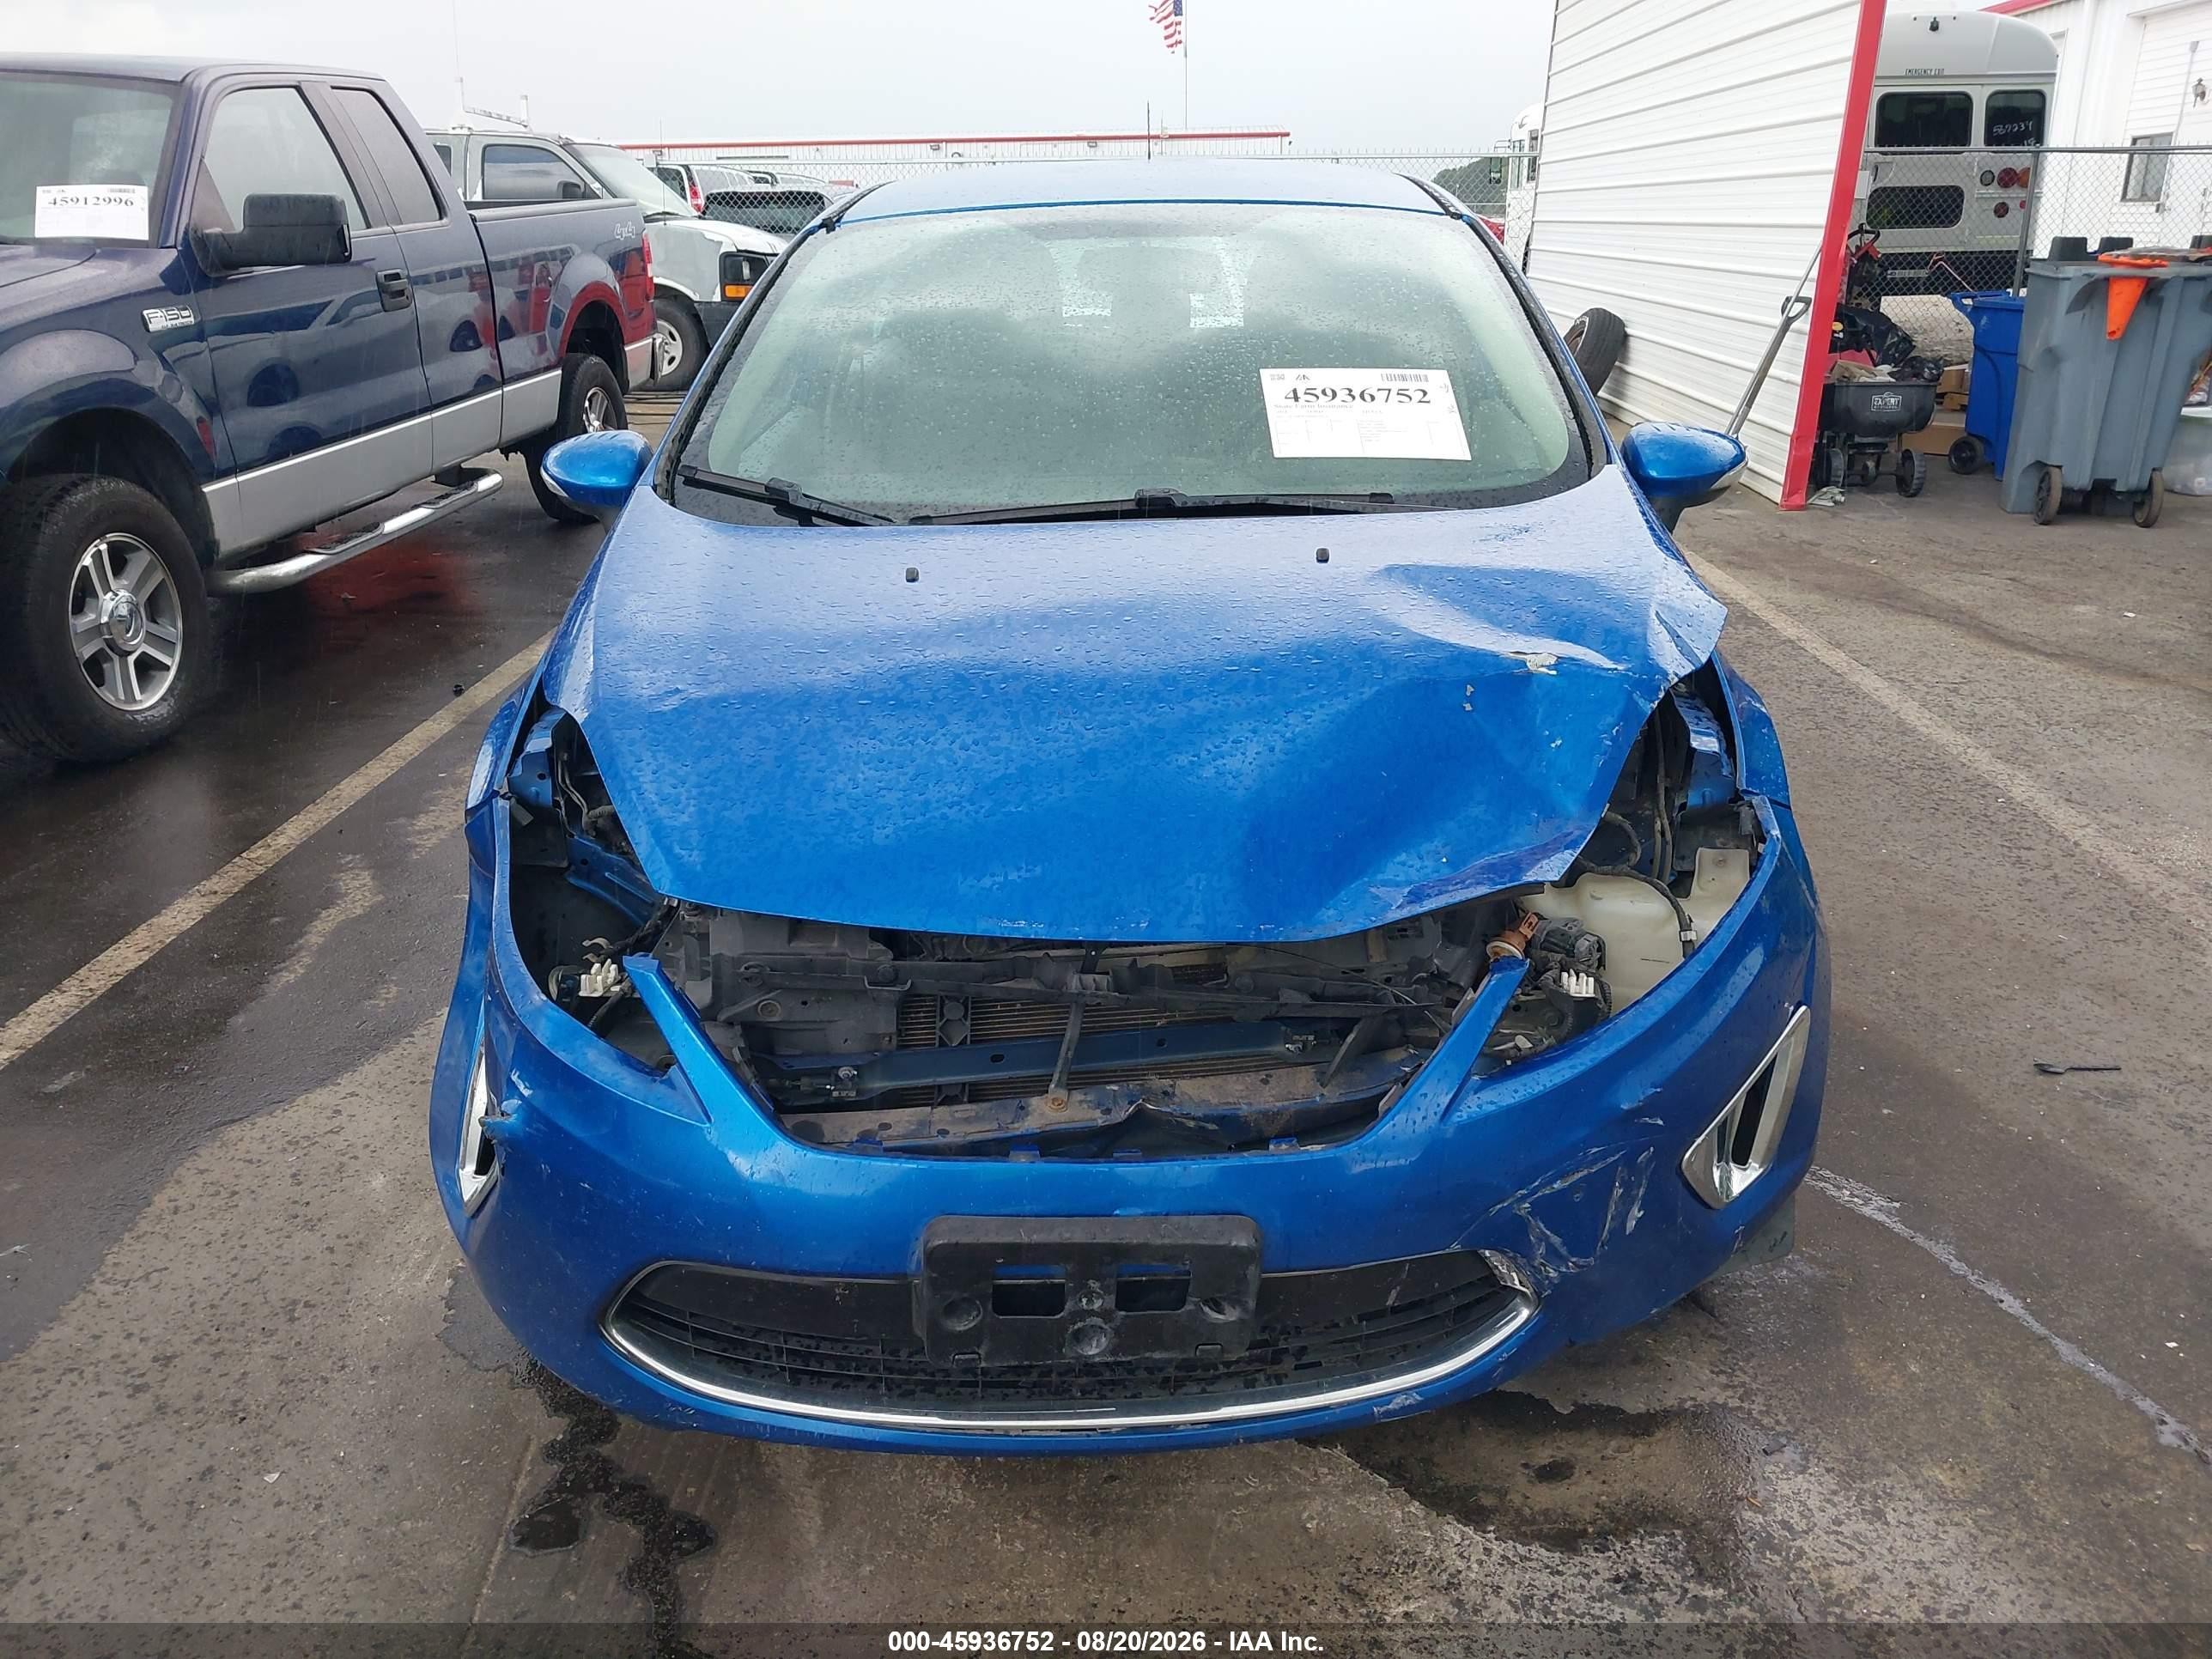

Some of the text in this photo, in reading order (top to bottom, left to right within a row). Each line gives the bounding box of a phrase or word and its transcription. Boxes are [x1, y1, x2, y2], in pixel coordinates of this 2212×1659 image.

[1905, 68, 1932, 76] EMERGENCY
[48, 196, 134, 207] 45912996
[1284, 386, 1431, 404] 45936752
